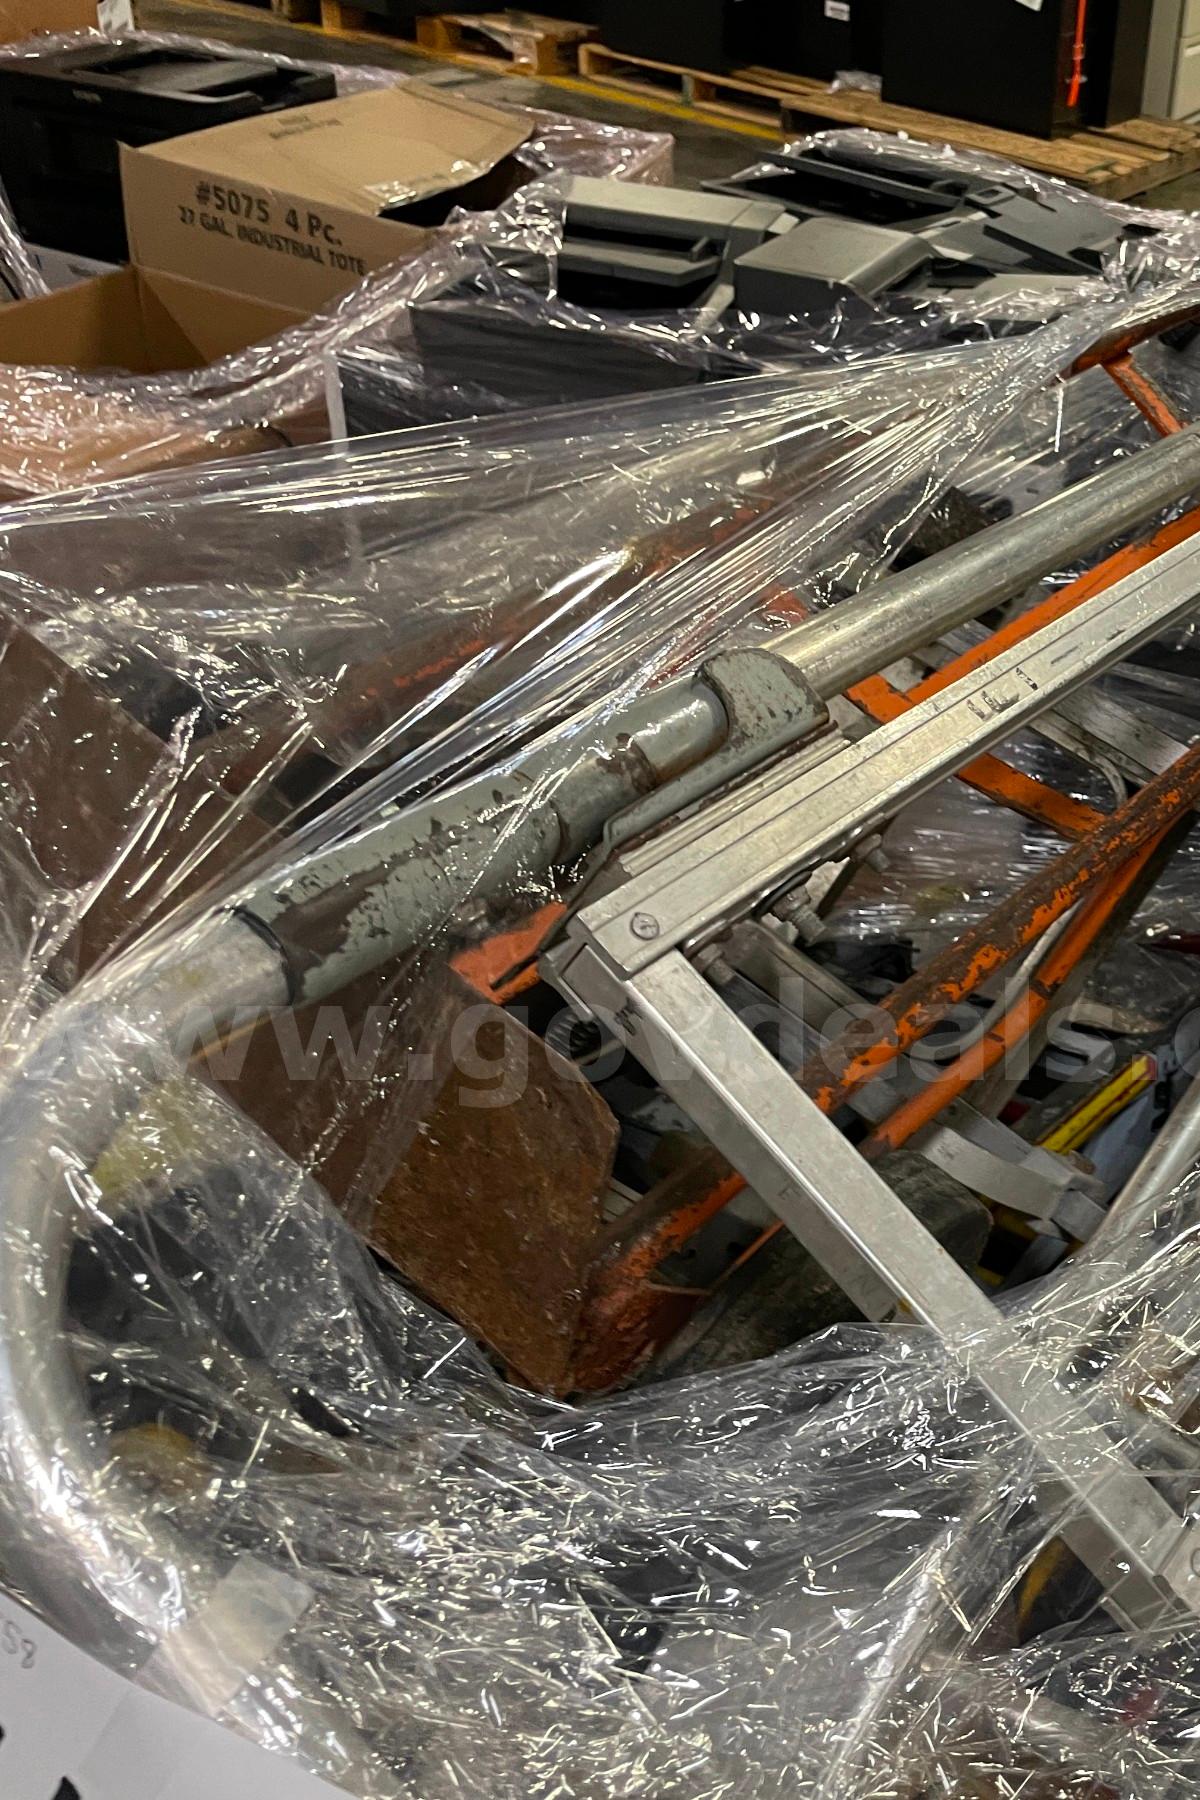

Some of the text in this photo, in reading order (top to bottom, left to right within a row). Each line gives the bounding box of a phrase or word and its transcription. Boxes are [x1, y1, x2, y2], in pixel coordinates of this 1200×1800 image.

[195, 180, 269, 223] #5075
[284, 208, 300, 232] 4
[237, 224, 326, 265] INDUSTRIAL
[328, 249, 368, 277] TOTE
